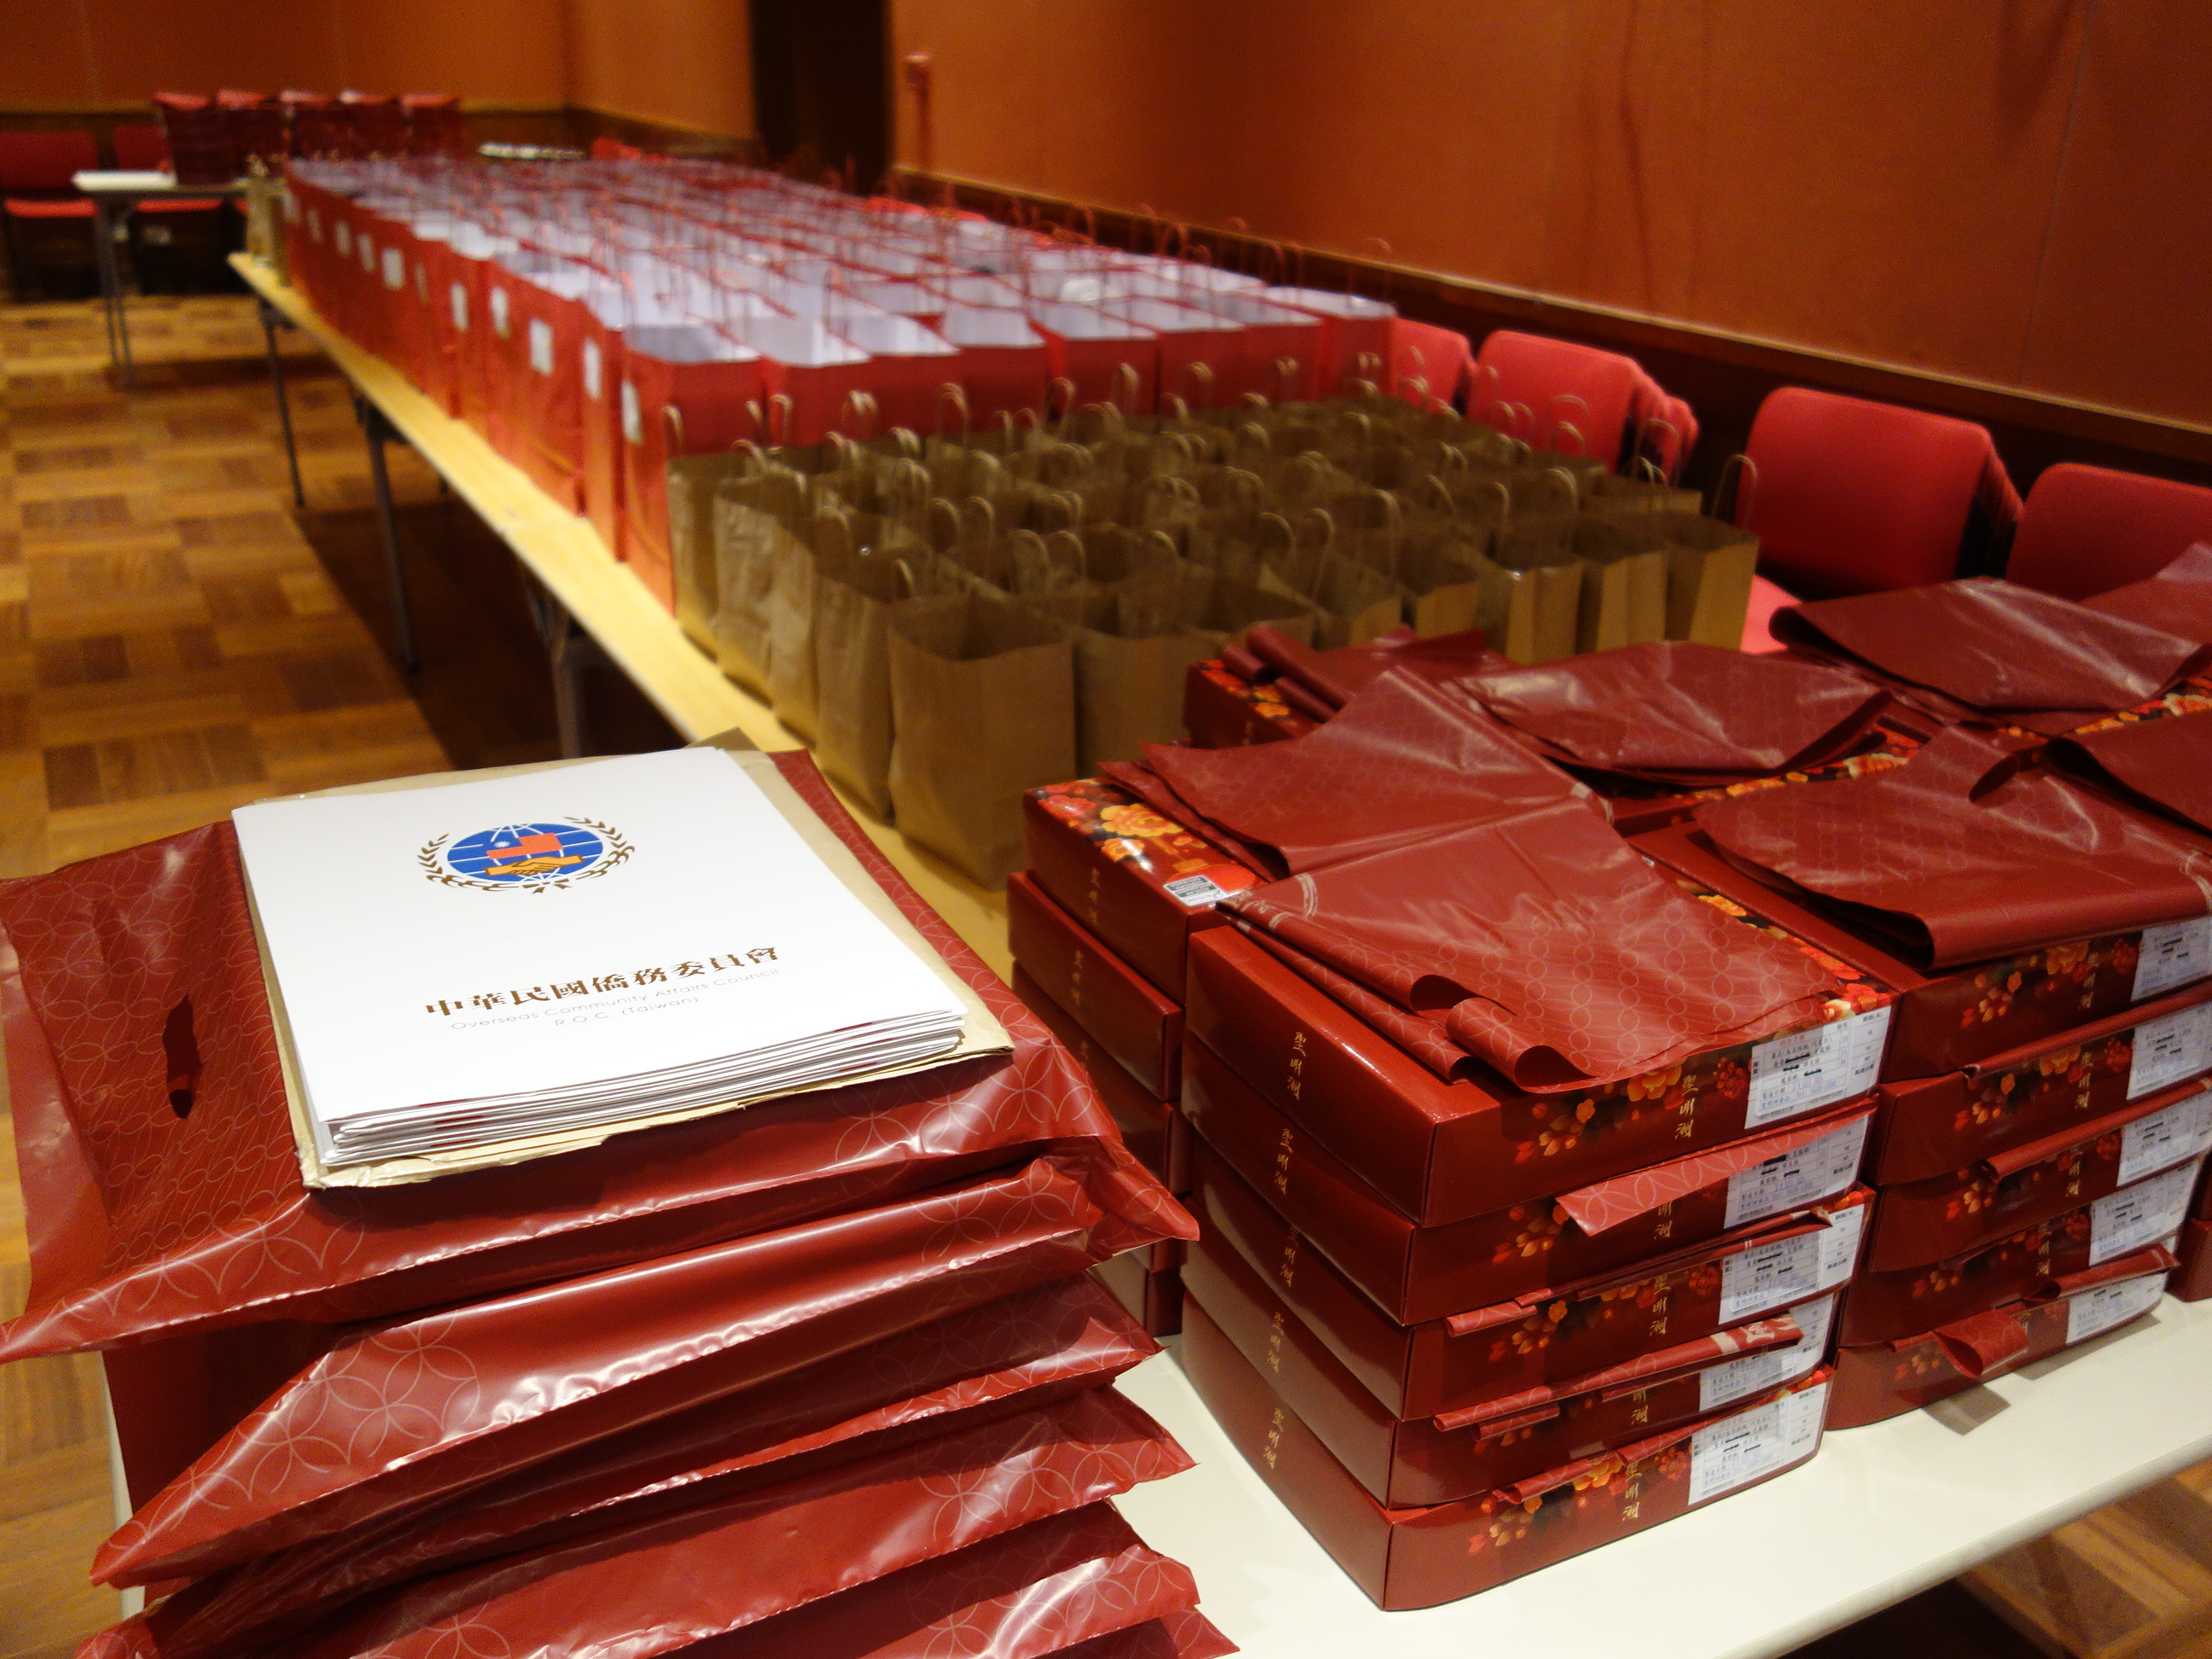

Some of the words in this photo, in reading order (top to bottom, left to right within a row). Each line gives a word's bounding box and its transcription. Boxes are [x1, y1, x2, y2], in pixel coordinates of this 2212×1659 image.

[425, 946, 778, 1016] 中華民國僑務委員會
[451, 1012, 539, 1030] Overseas
[544, 994, 647, 1016] Community
[655, 983, 708, 998] Affairs
[713, 968, 779, 987] Council
[554, 1011, 615, 1027] R.O.C.
[621, 996, 698, 1016] (Taiwan)
[1654, 1201, 1673, 1239] 明洲
